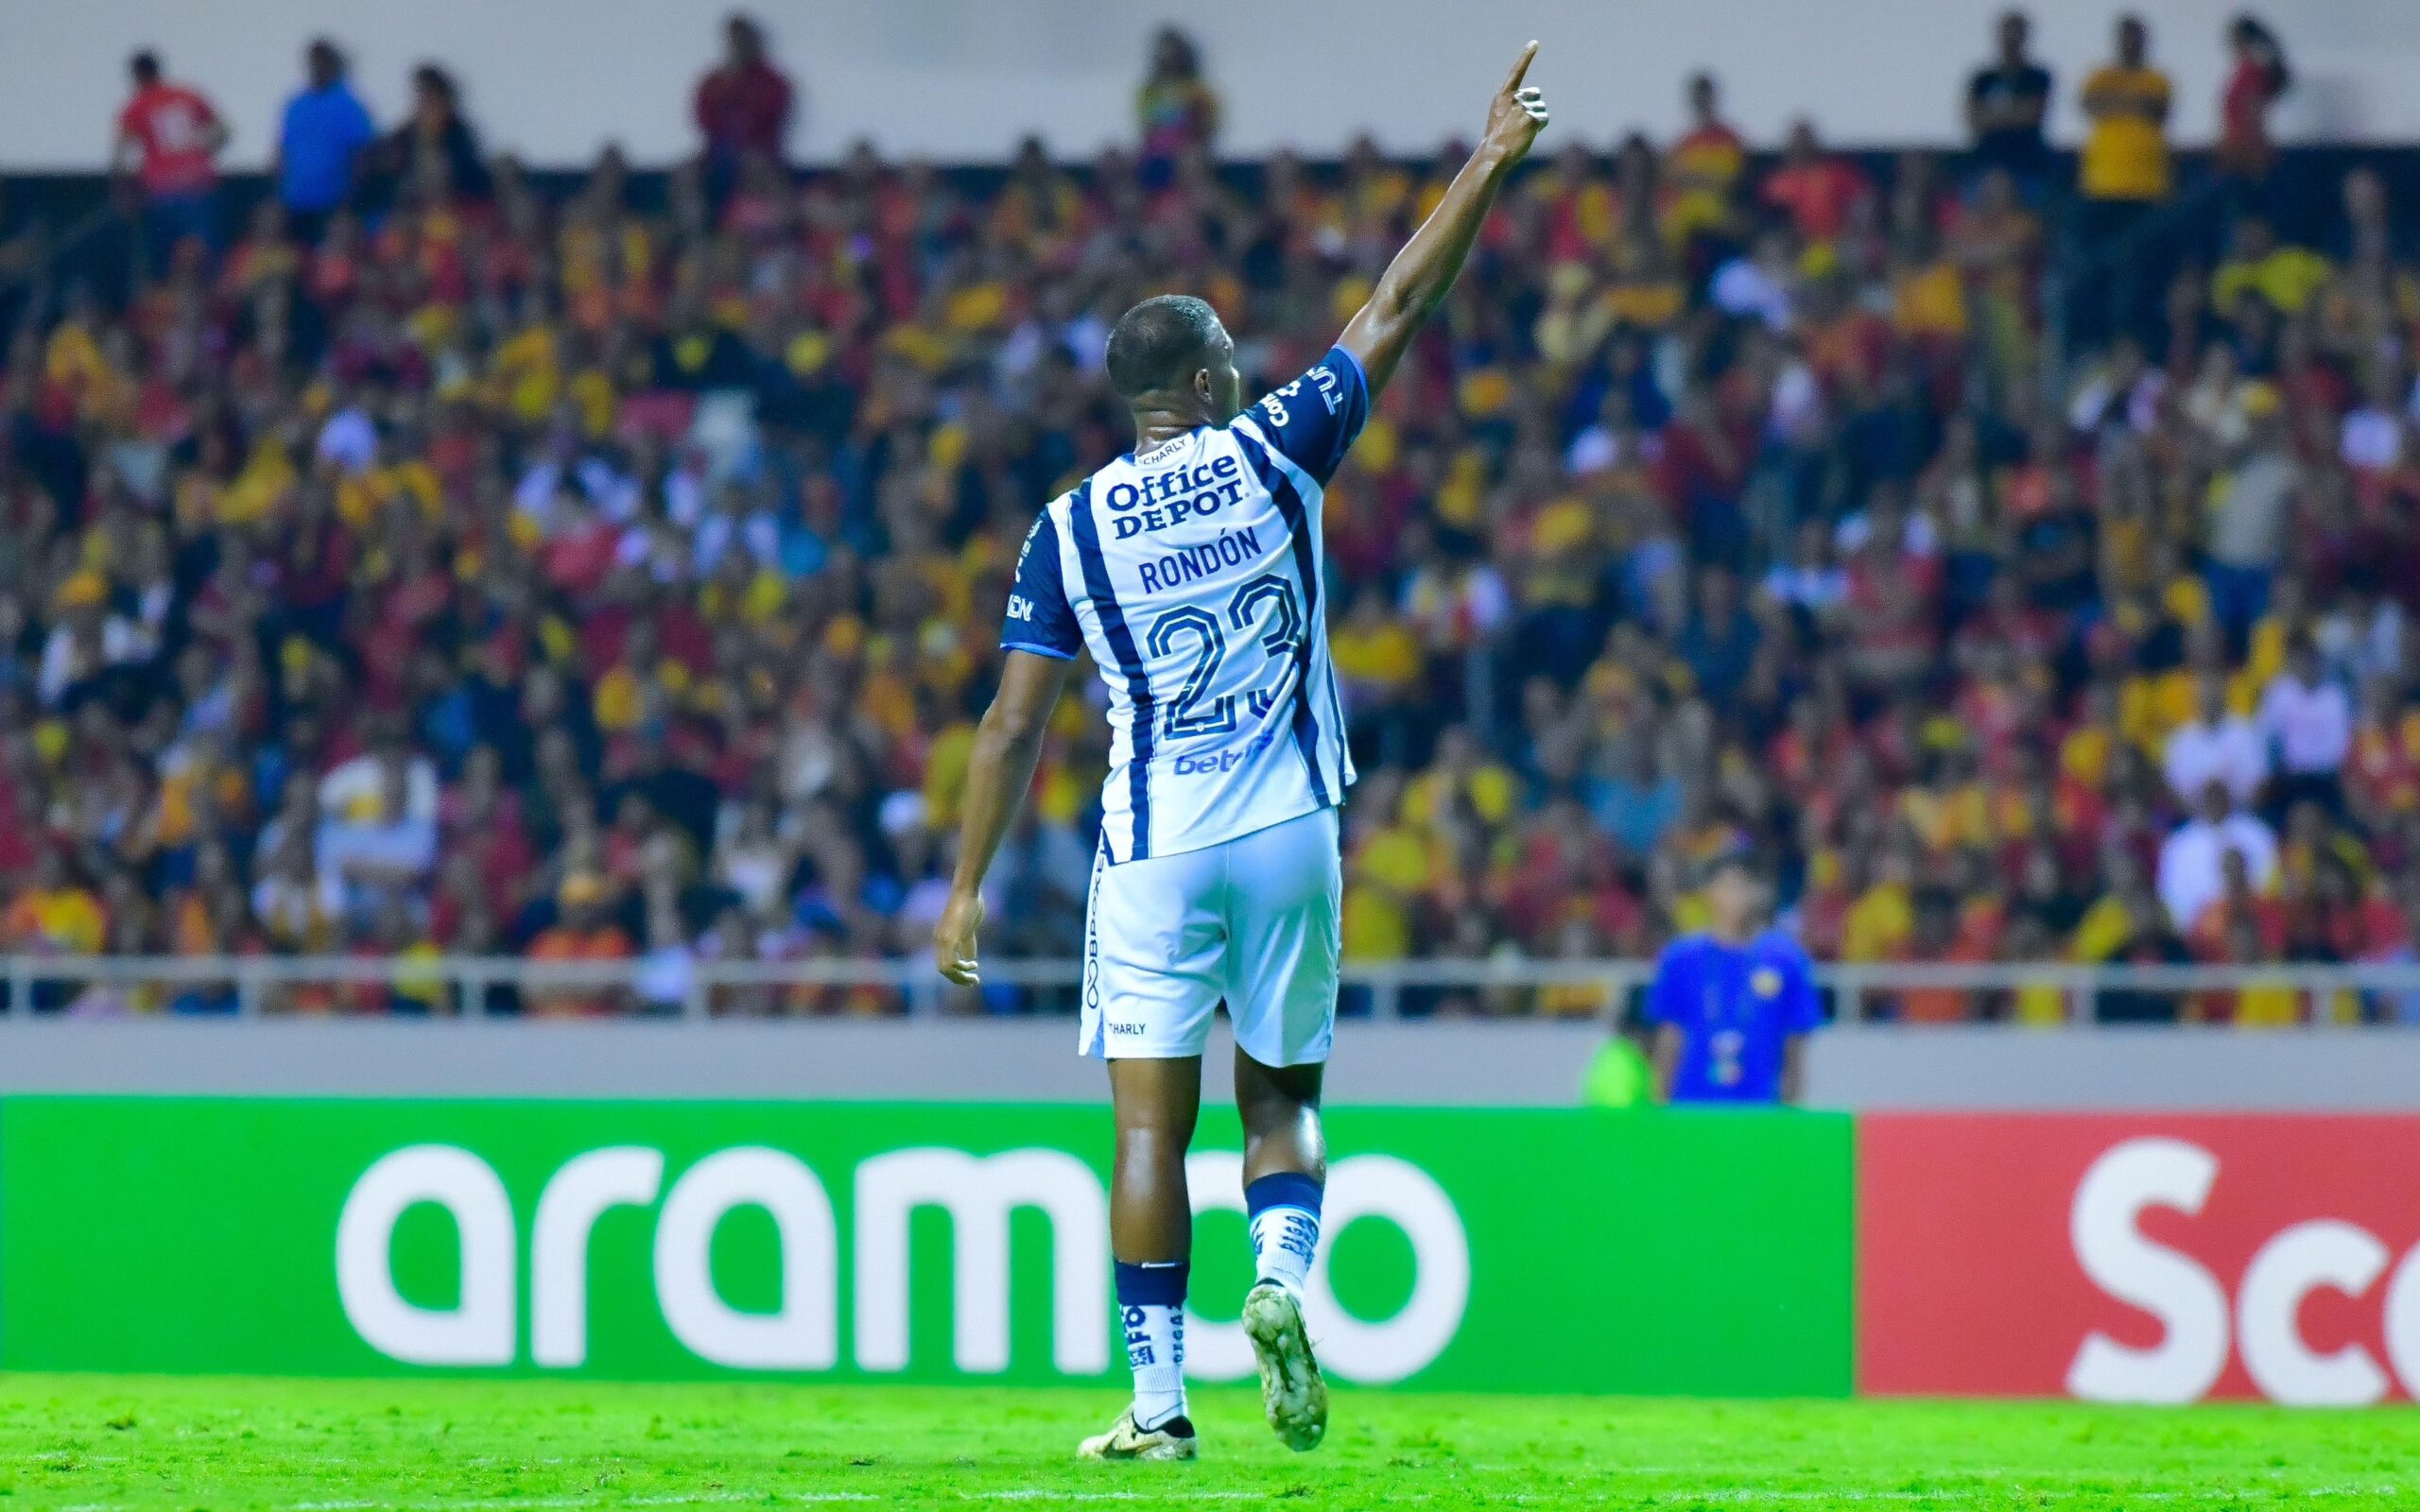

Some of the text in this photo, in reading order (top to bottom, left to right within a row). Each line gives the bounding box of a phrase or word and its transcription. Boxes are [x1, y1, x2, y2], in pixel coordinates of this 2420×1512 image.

[1306, 366, 1343, 416] TU
[1143, 438, 1185, 465] CHARLY
[1106, 455, 1238, 512] Office
[1113, 478, 1245, 540] DEPOT
[1138, 526, 1263, 594] RONDÓN
[1146, 573, 1302, 741] 23
[1109, 1022, 1147, 1036] HARLY
